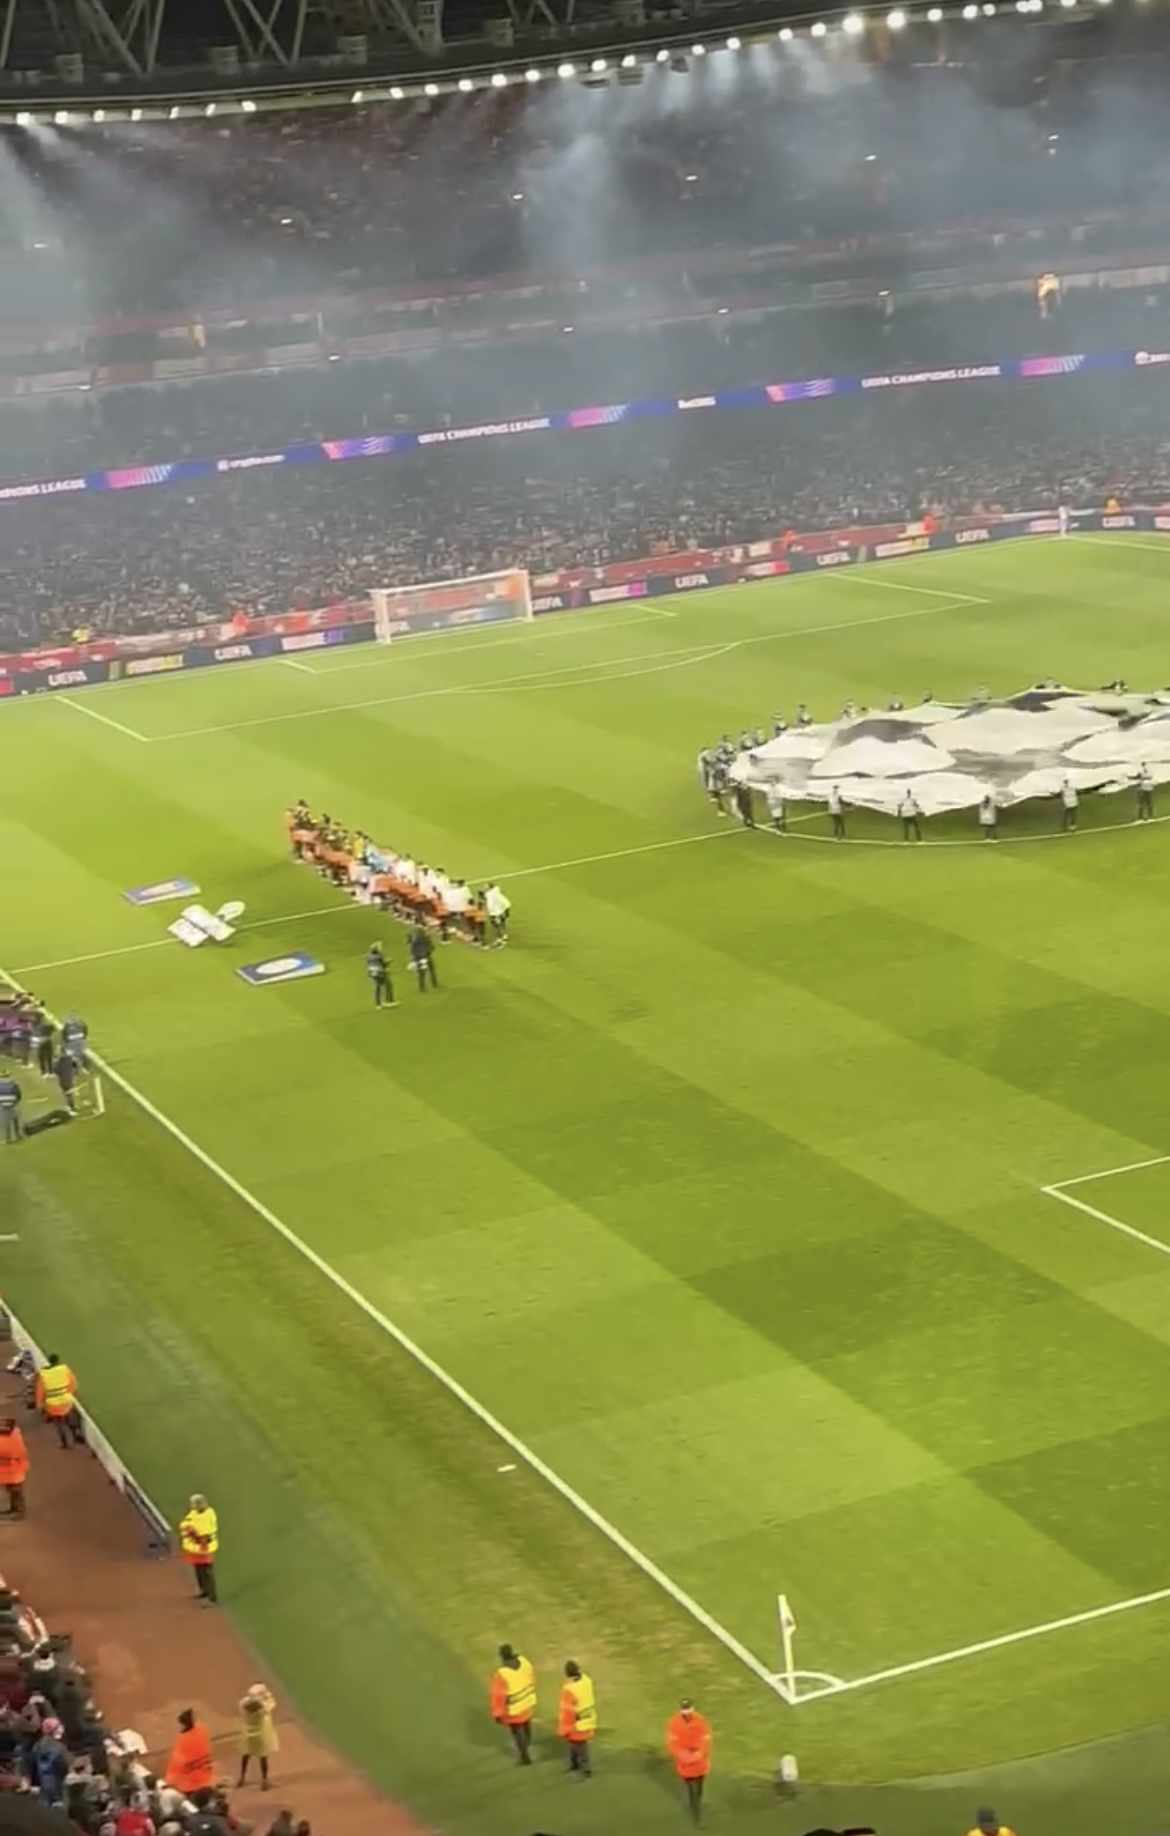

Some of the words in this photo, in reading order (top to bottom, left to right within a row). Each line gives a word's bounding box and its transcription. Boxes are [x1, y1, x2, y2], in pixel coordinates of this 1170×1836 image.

[891, 369, 957, 385] CHAMPIONS
[958, 365, 1000, 379] LEAGUE
[509, 418, 550, 432] LEAGUE
[41, 479, 86, 494] LEAGUE
[1102, 515, 1135, 528] UEFA
[955, 528, 990, 543] UEFA
[817, 551, 850, 565] UEFA
[674, 573, 708, 588] UEFA
[214, 644, 252, 660] UEFA
[48, 669, 88, 687] UEFA
